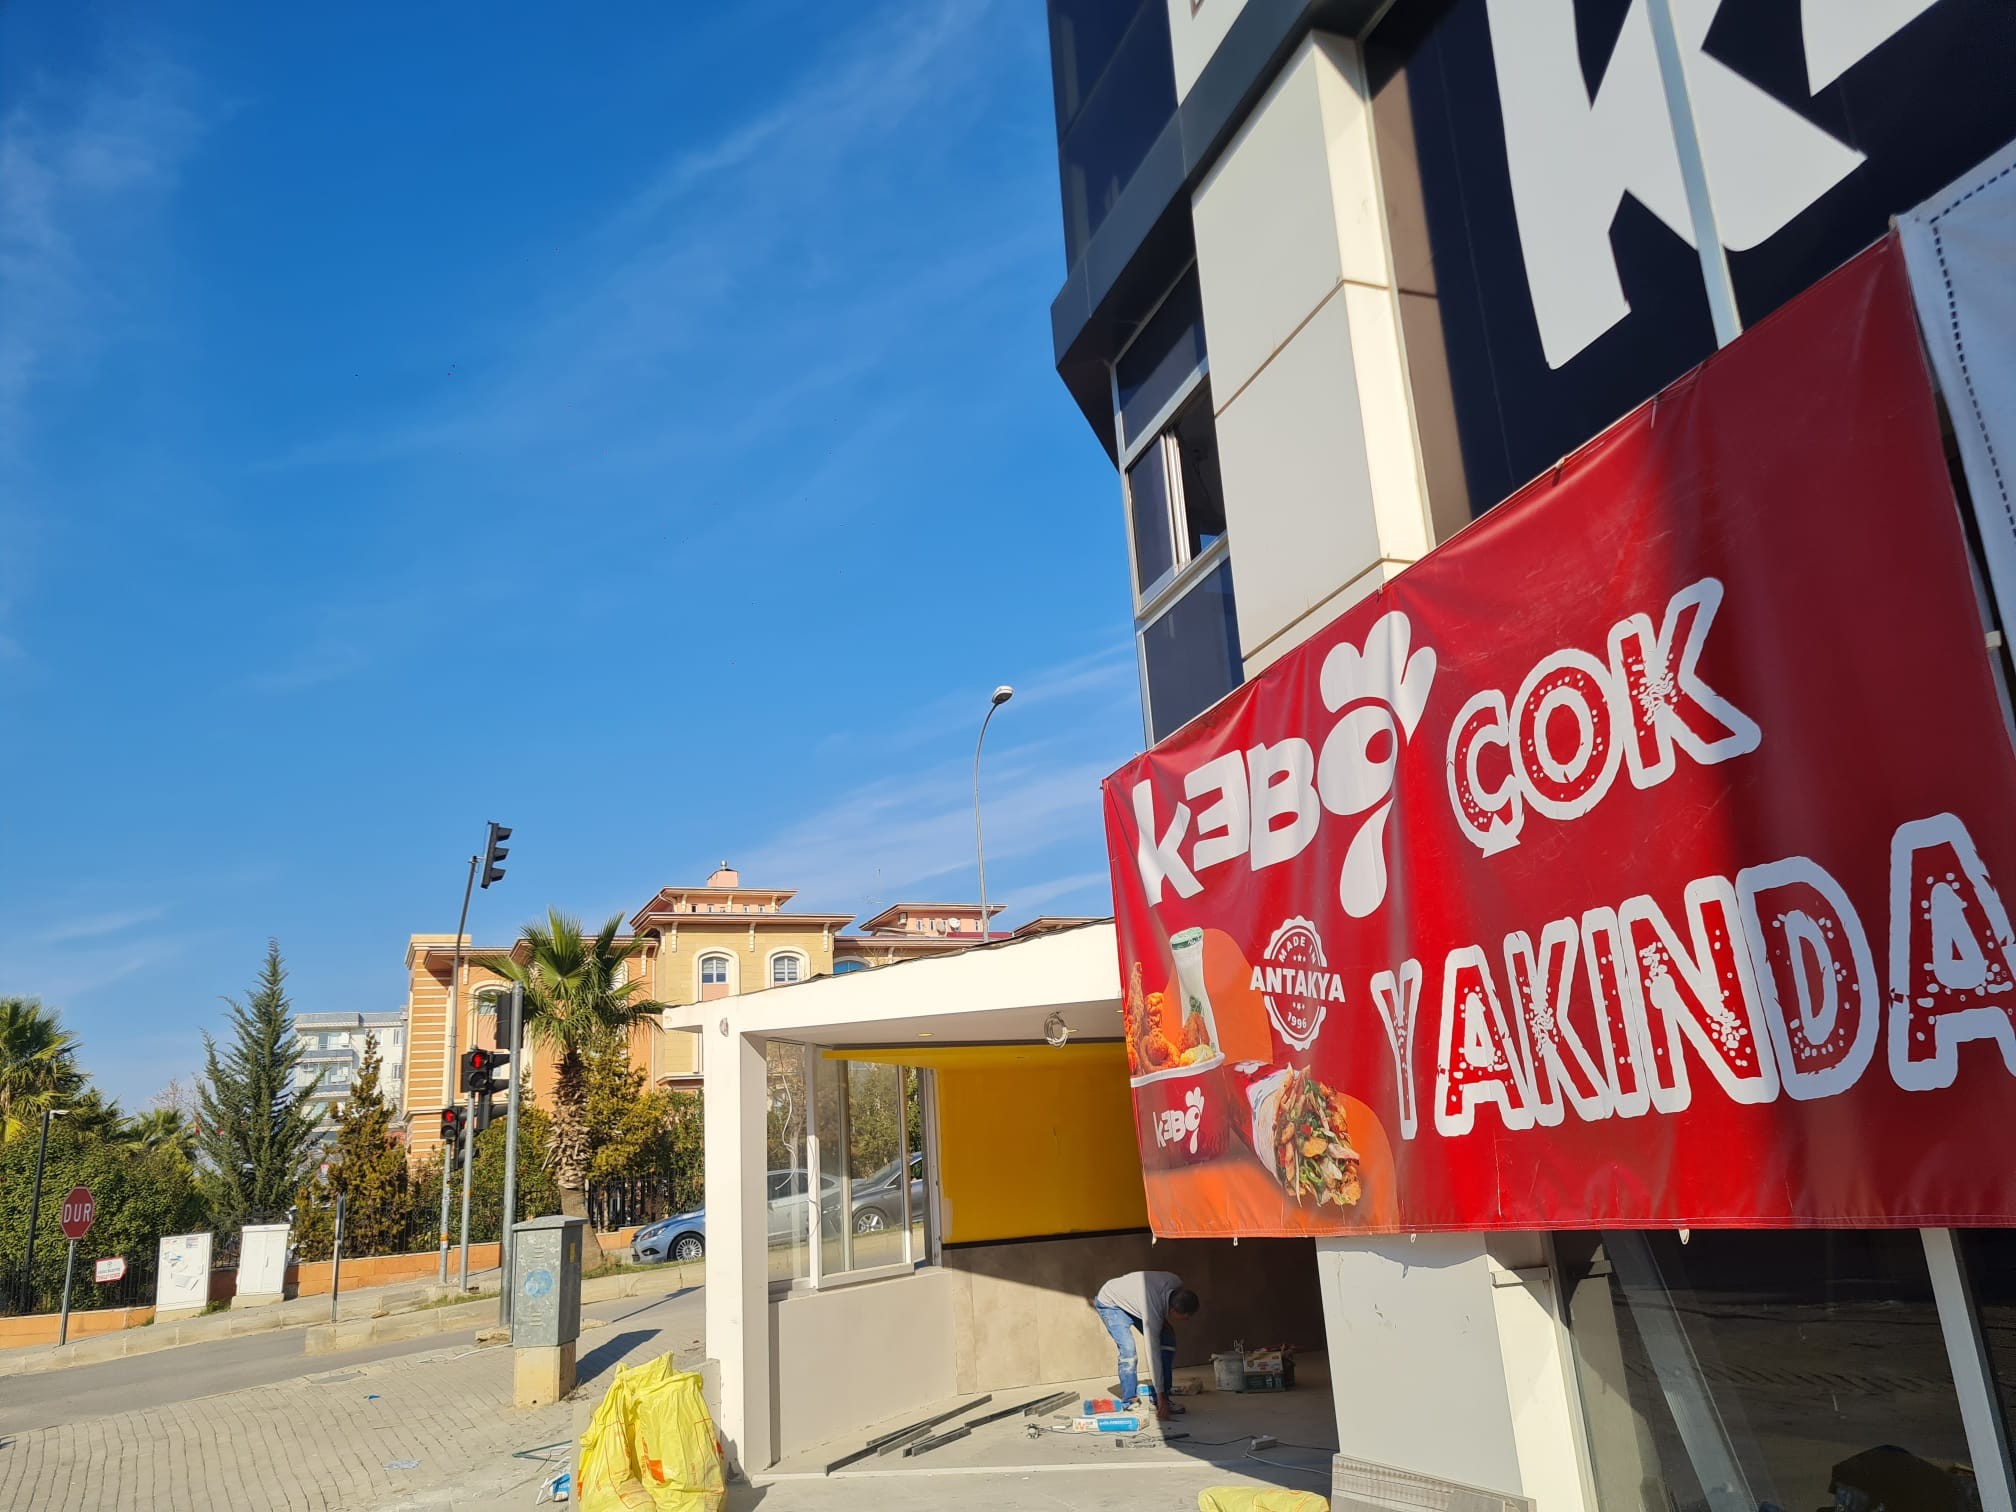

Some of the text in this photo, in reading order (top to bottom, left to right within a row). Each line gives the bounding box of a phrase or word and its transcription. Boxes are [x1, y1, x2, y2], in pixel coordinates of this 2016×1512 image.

[1446, 577, 1762, 858] ÇOK
[1278, 935, 1318, 964] MADE IN
[1249, 965, 1346, 1003] ANTAKYA
[1370, 812, 2016, 1139] YAKINDA
[1286, 1011, 1308, 1030] 1996
[63, 1202, 92, 1224] DUR
